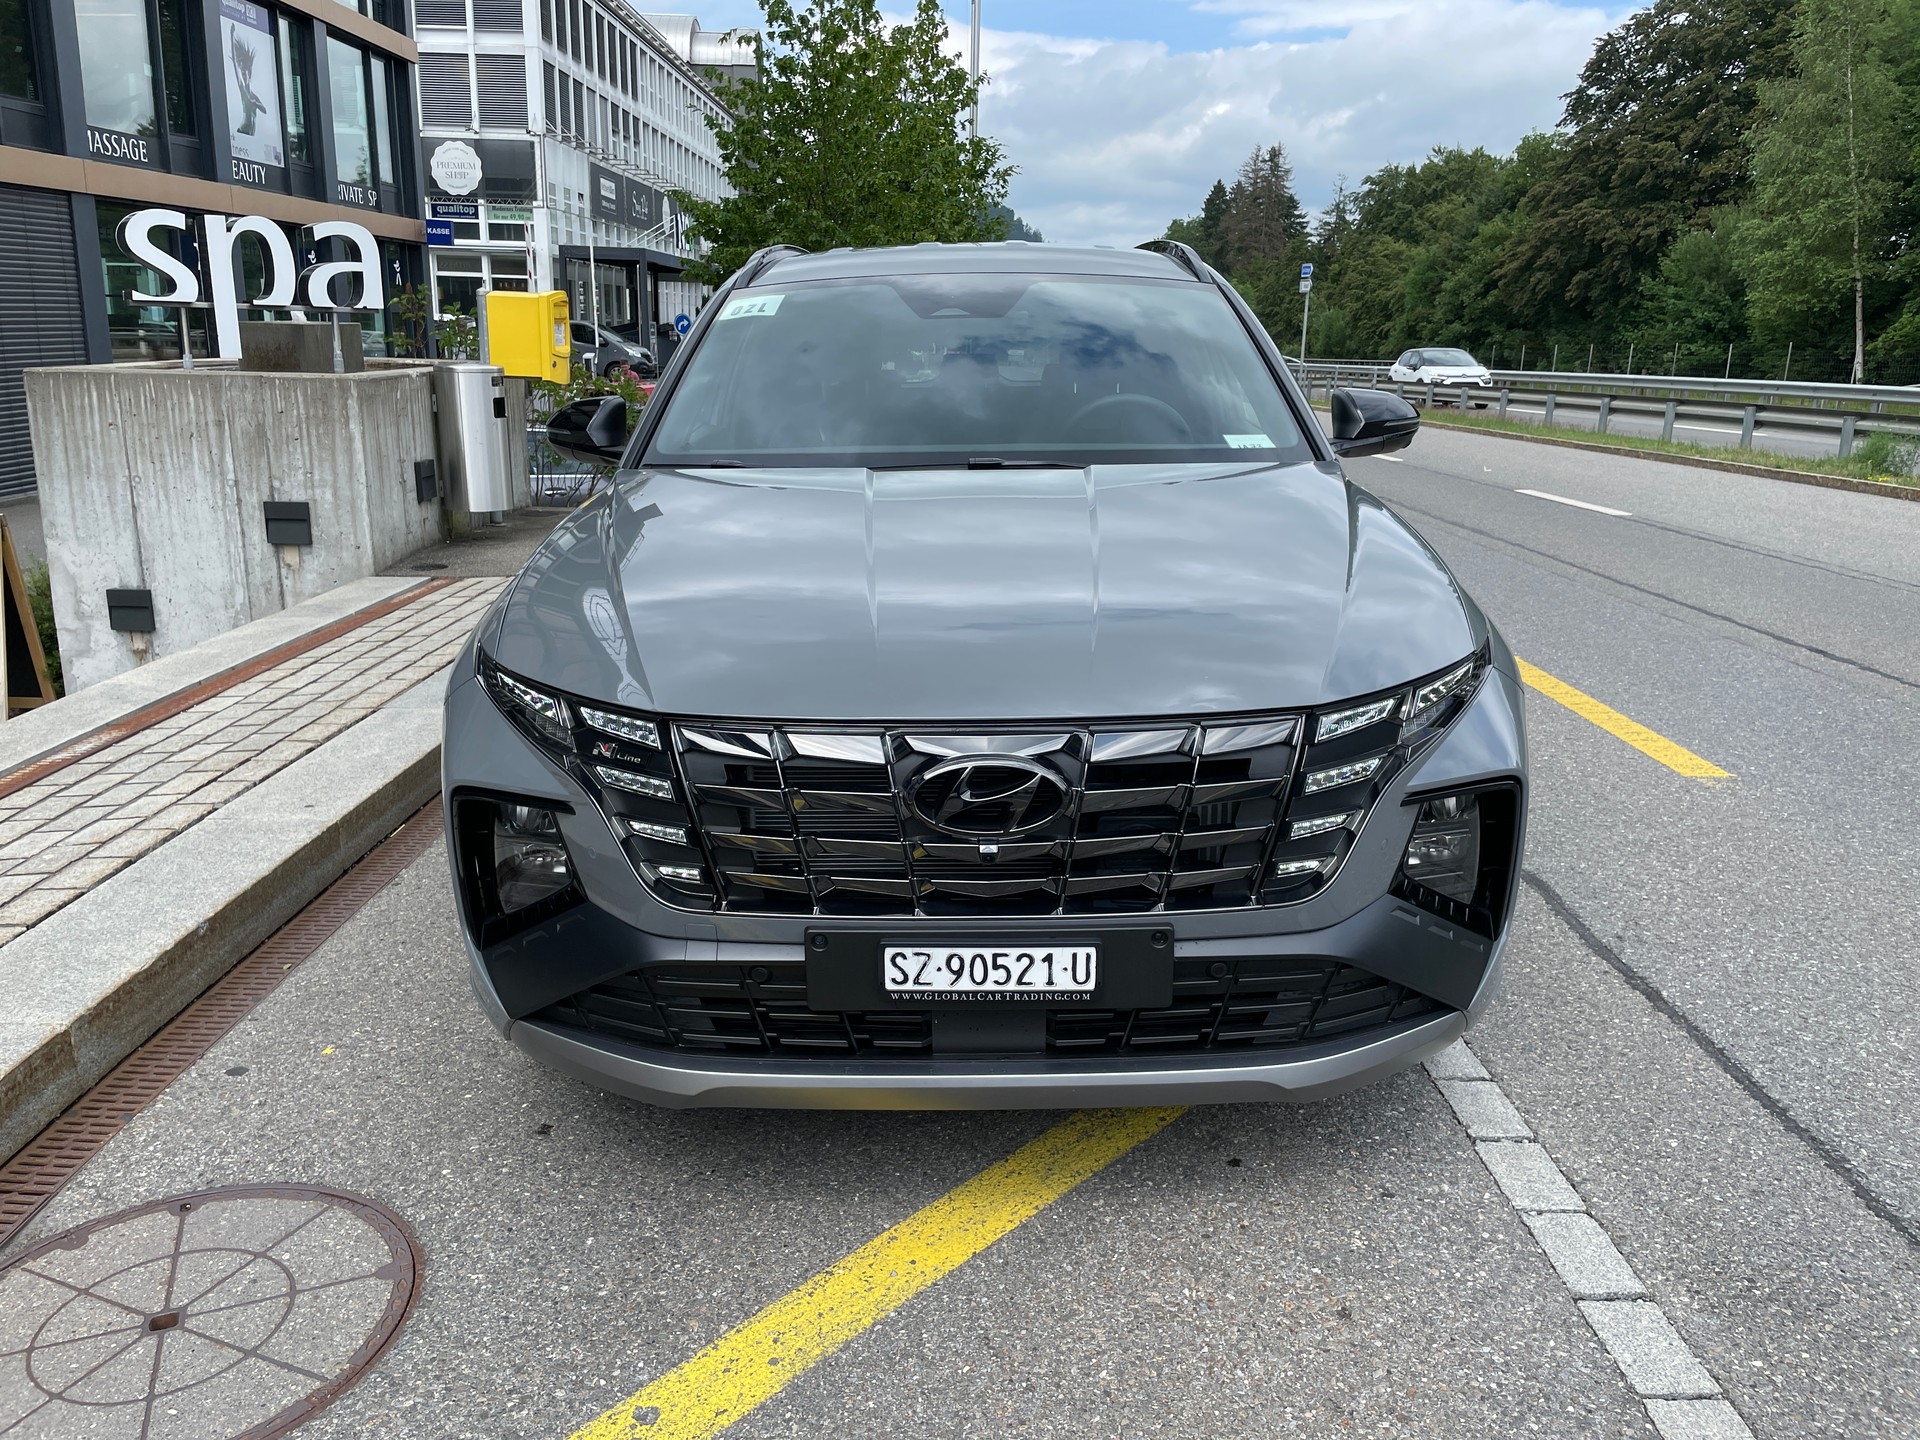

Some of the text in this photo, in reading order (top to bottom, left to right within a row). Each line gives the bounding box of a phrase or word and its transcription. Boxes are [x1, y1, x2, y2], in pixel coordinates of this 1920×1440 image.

[436, 161, 476, 170] PREMIUM
[445, 171, 469, 179] SHOP
[437, 205, 475, 215] qualitop
[427, 227, 450, 235] KASSE
[116, 208, 384, 359] spa
[617, 753, 641, 763] Line
[890, 991, 1091, 1001] WWW.GLOBALCARTRADING.COM
